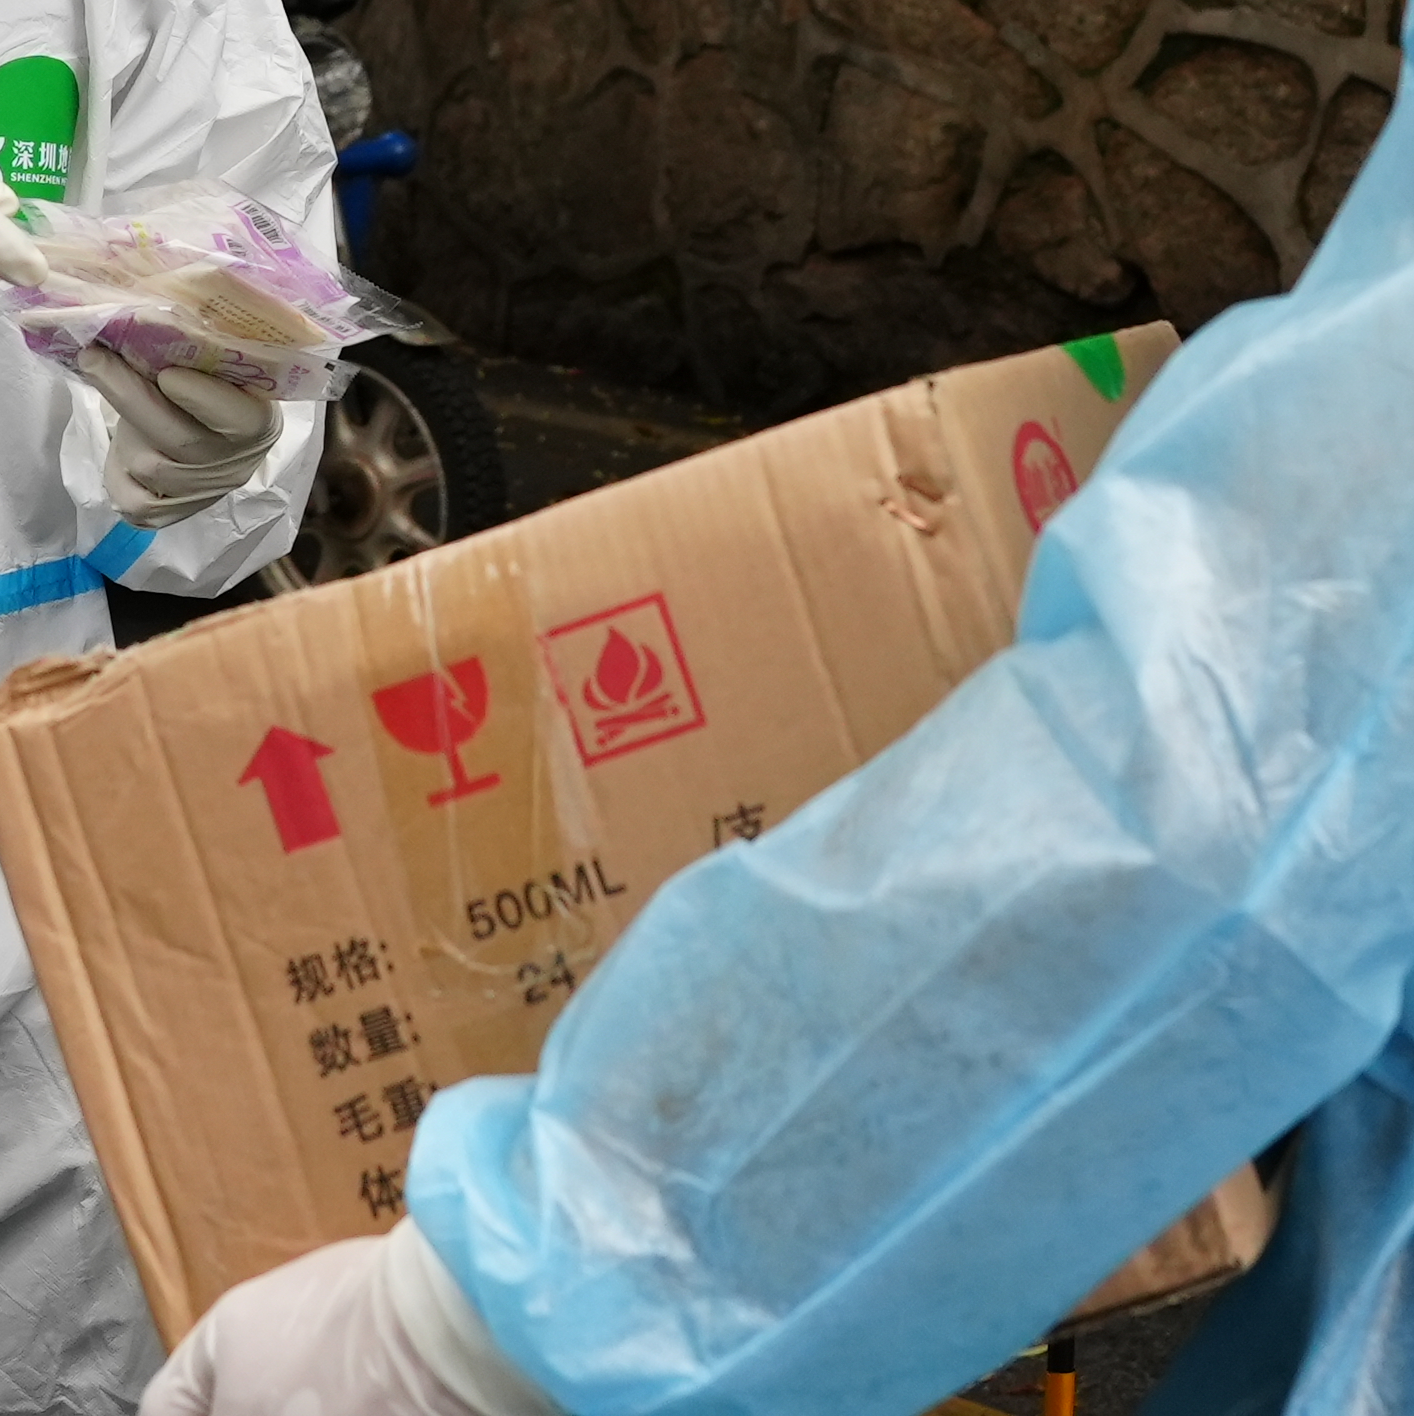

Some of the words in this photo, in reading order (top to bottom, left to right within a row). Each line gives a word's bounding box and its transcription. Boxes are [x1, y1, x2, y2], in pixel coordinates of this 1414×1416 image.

[11, 139, 72, 174] 深圳地
[287, 936, 395, 1005] 规格:
[465, 856, 627, 942] 500ML
[308, 1004, 422, 1079] 数量:
